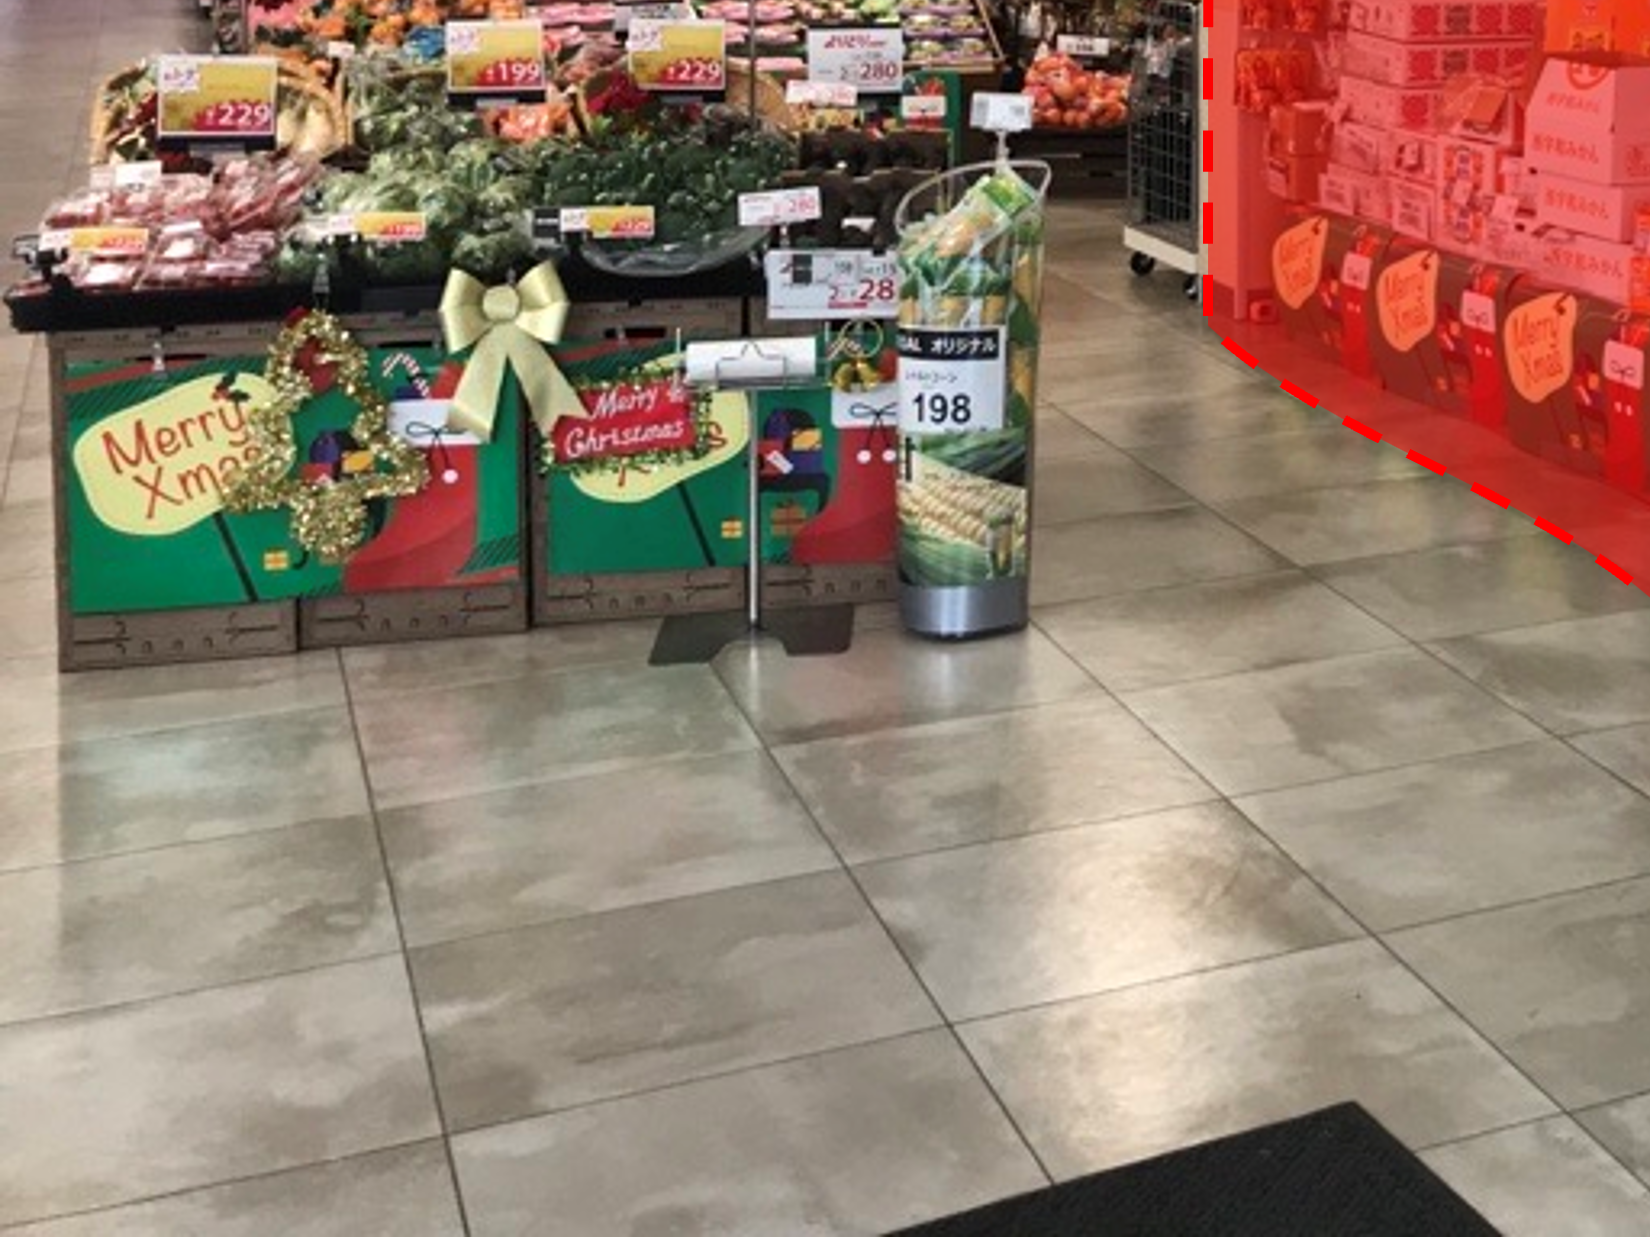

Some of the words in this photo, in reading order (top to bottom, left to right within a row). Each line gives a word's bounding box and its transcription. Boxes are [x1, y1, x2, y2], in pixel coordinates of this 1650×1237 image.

[860, 62, 898, 80] 280
[859, 278, 895, 301] 28
[930, 336, 996, 354] オリジナル
[591, 386, 659, 419] Merry
[913, 392, 972, 424] 198
[102, 407, 248, 475] Merry
[564, 420, 684, 458] Christmas
